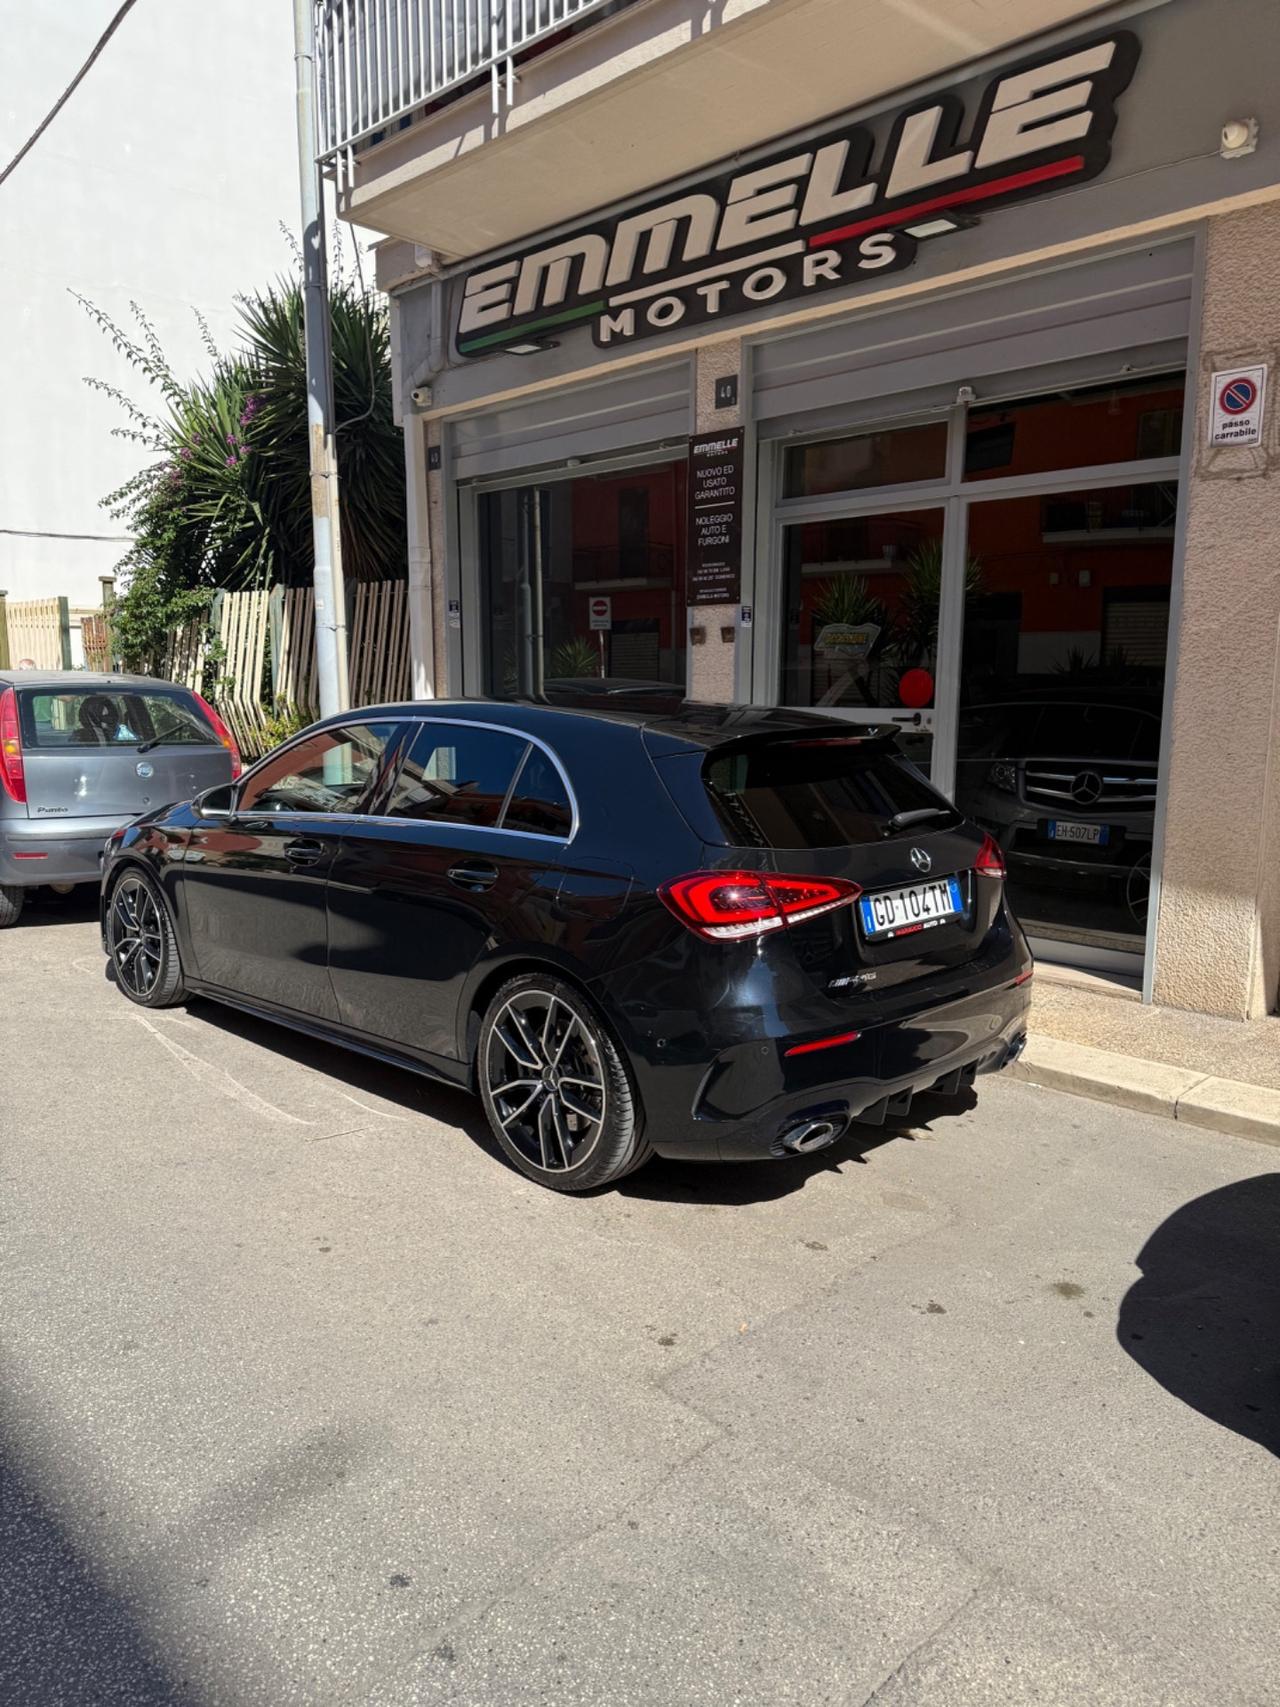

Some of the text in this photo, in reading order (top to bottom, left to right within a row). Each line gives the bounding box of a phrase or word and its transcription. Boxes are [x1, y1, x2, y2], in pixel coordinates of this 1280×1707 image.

[458, 41, 1115, 333] EMMELLE
[598, 232, 896, 343] MOTORS
[1222, 419, 1250, 430] passo
[1215, 428, 1257, 440] carrabile
[693, 438, 739, 454] EMMELLE
[696, 465, 734, 478] NUOVO ED
[703, 477, 727, 488] USATO
[695, 487, 735, 499] GARANTITO
[695, 513, 733, 525] NOLEGGIO
[701, 525, 727, 536] AUTO E
[697, 535, 730, 546] FURGONI
